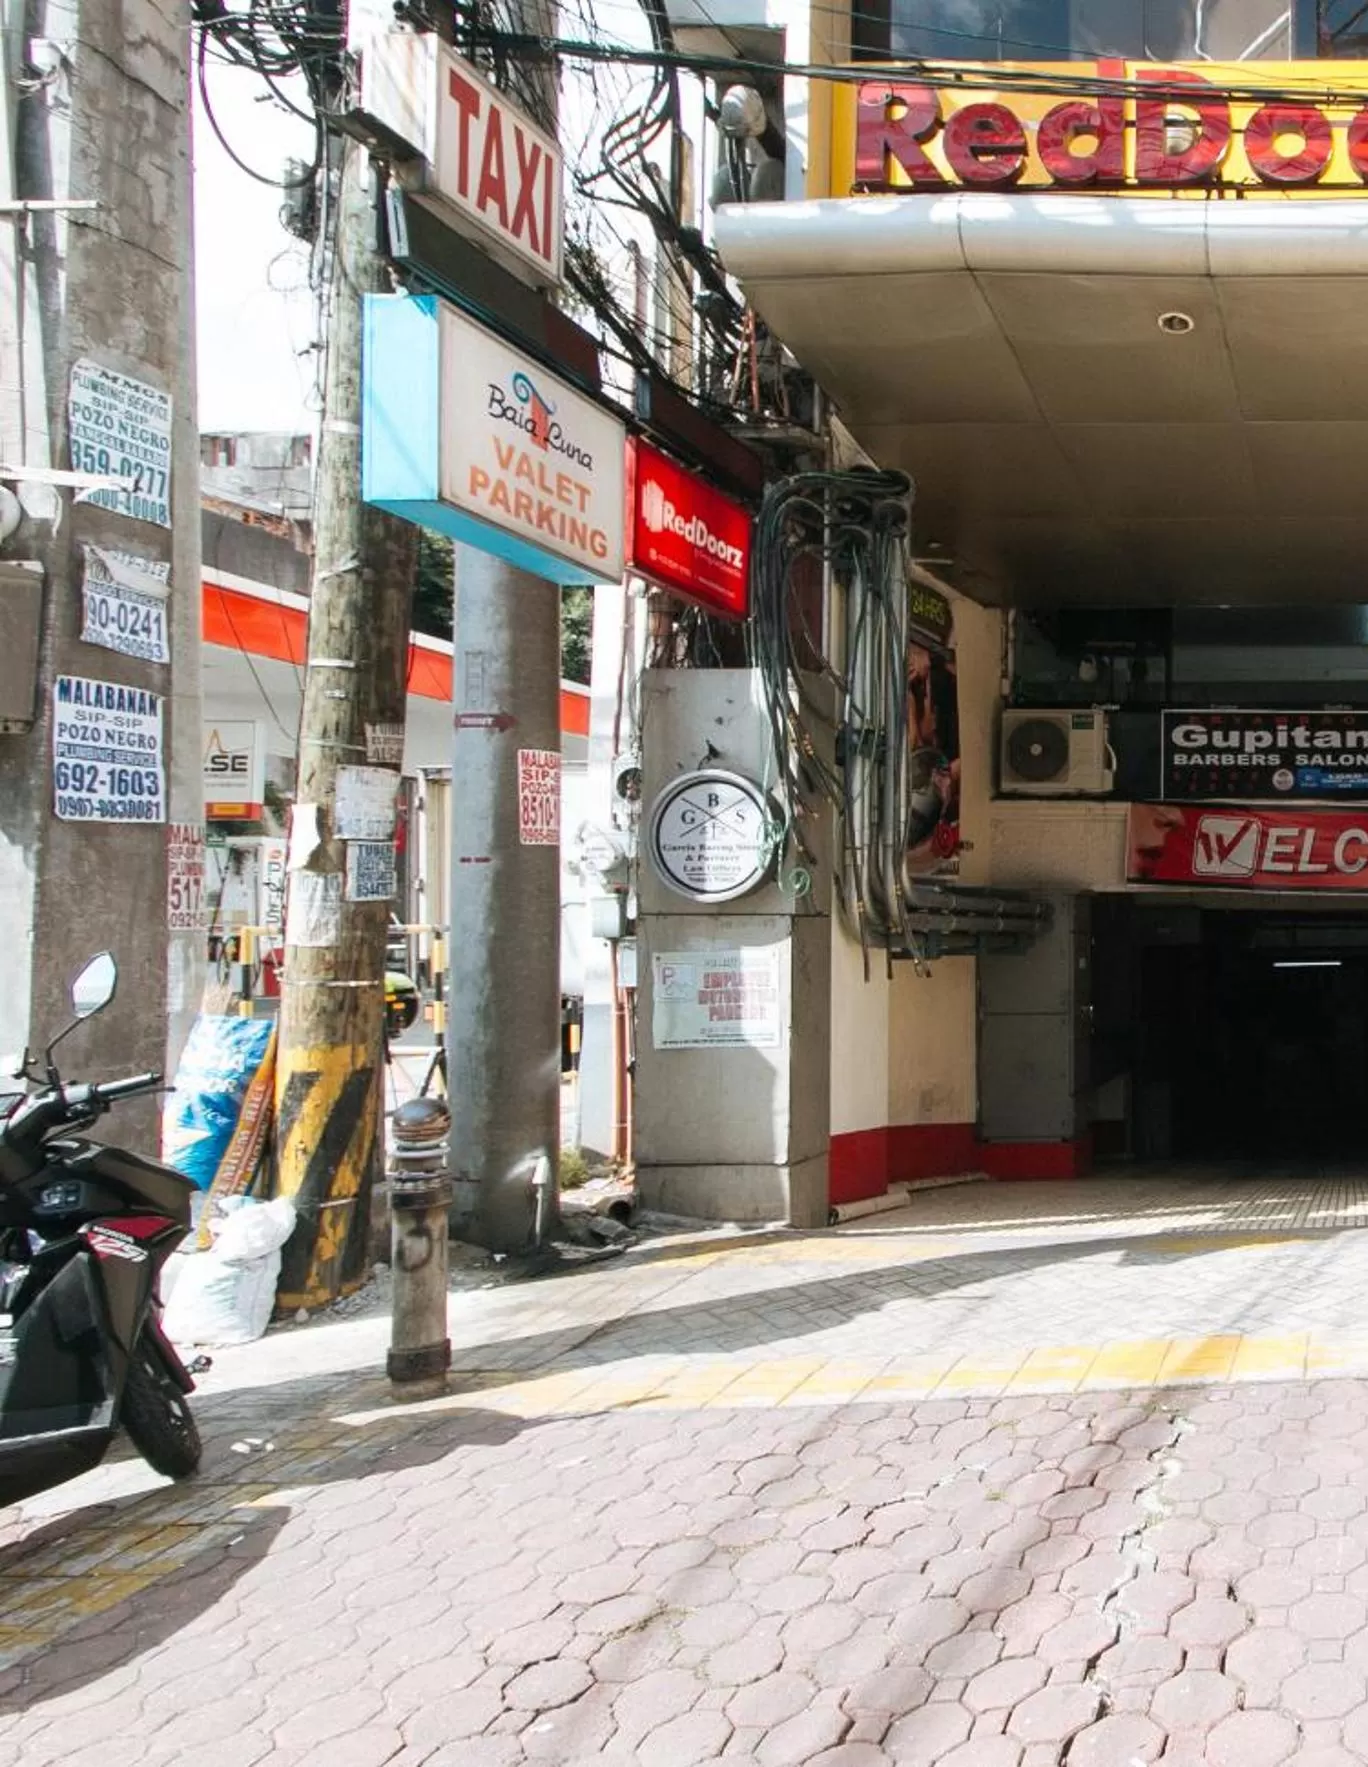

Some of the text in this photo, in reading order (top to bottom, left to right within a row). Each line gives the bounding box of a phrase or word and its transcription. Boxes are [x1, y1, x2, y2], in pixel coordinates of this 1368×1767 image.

[449, 68, 554, 263] TAXI
[73, 402, 114, 430] POZO
[118, 420, 170, 451] NEGRO
[488, 384, 593, 471] Baia Luna
[492, 434, 592, 513] VALET
[469, 465, 608, 558] PARKING
[664, 500, 744, 568] RedDoorz
[58, 722, 157, 751] POZO NEGRO
[75, 709, 143, 729] SIP-SIP
[56, 762, 160, 796] 692-1603
[1173, 754, 1281, 766] BARBERS
[681, 809, 695, 825] G
[708, 793, 719, 808] B
